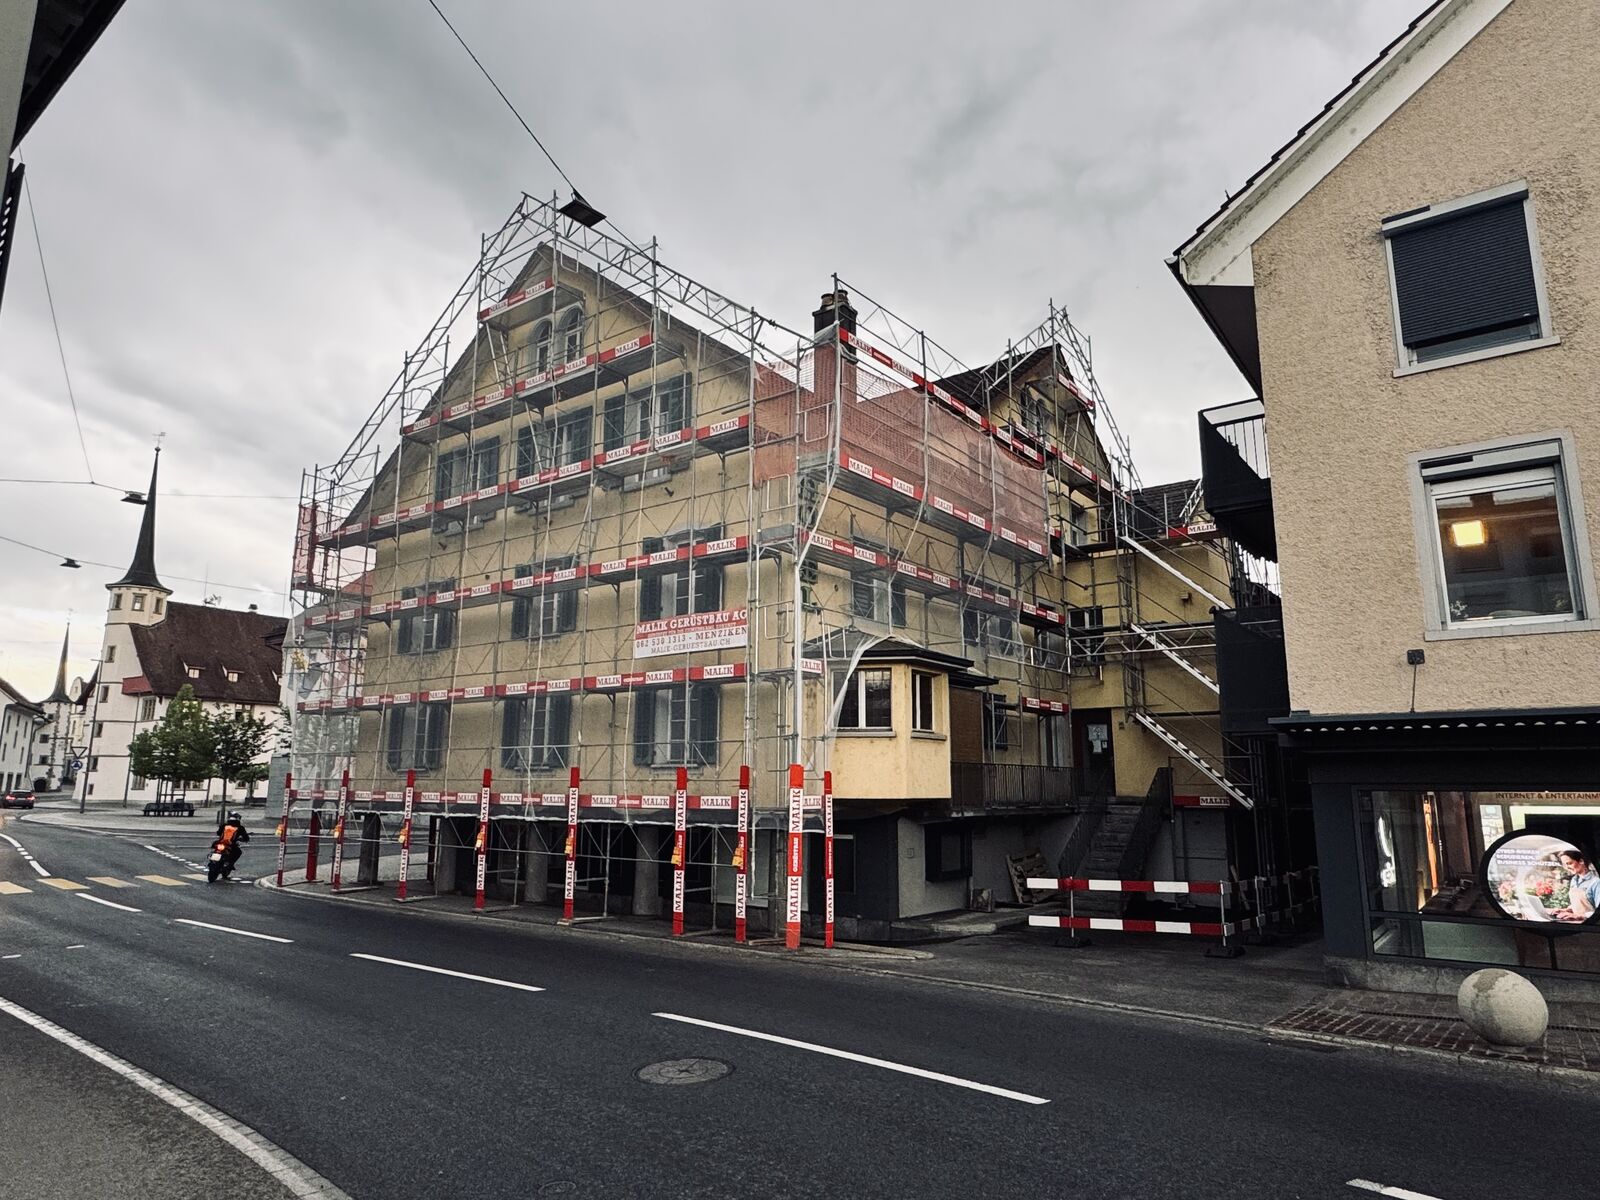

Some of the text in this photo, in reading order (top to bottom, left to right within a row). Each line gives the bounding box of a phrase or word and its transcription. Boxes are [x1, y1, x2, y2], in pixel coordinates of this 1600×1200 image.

[616, 341, 640, 353] MALIK
[565, 359, 586, 370] MALIK
[526, 375, 546, 386] MALIK
[711, 420, 738, 433] MALIK
[656, 433, 680, 446] MALIK
[607, 448, 630, 460] MALIK
[559, 464, 581, 475] MALIK
[849, 460, 872, 478] MALIK
[519, 476, 539, 487] MALIK
[893, 479, 914, 496] MALIK
[1189, 523, 1217, 533] MALIK
[708, 540, 736, 552] MALIK
[651, 552, 676, 563] MALIK
[855, 548, 876, 561] MALIK
[602, 561, 626, 571] MALIK
[553, 570, 576, 580] MALIK
[513, 577, 533, 588] MALIK
[637, 621, 667, 634] MALIK
[670, 613, 730, 629] GERÜSTBAU
[732, 609, 747, 620] AG
[668, 635, 686, 644] 1313
[696, 626, 748, 641] MENZIKEN
[646, 671, 672, 682] MALIK
[705, 667, 733, 677] MALIK
[548, 681, 570, 691] MALIK
[598, 676, 621, 686] MALIK
[507, 684, 527, 694] MALIK
[543, 796, 565, 804] MALIK
[592, 797, 616, 805] MALIK
[642, 798, 669, 806] MALIK
[702, 798, 731, 806] MALIK
[1201, 797, 1229, 805] MALIK
[792, 790, 800, 831] MALIK
[790, 878, 799, 920] MALIK
